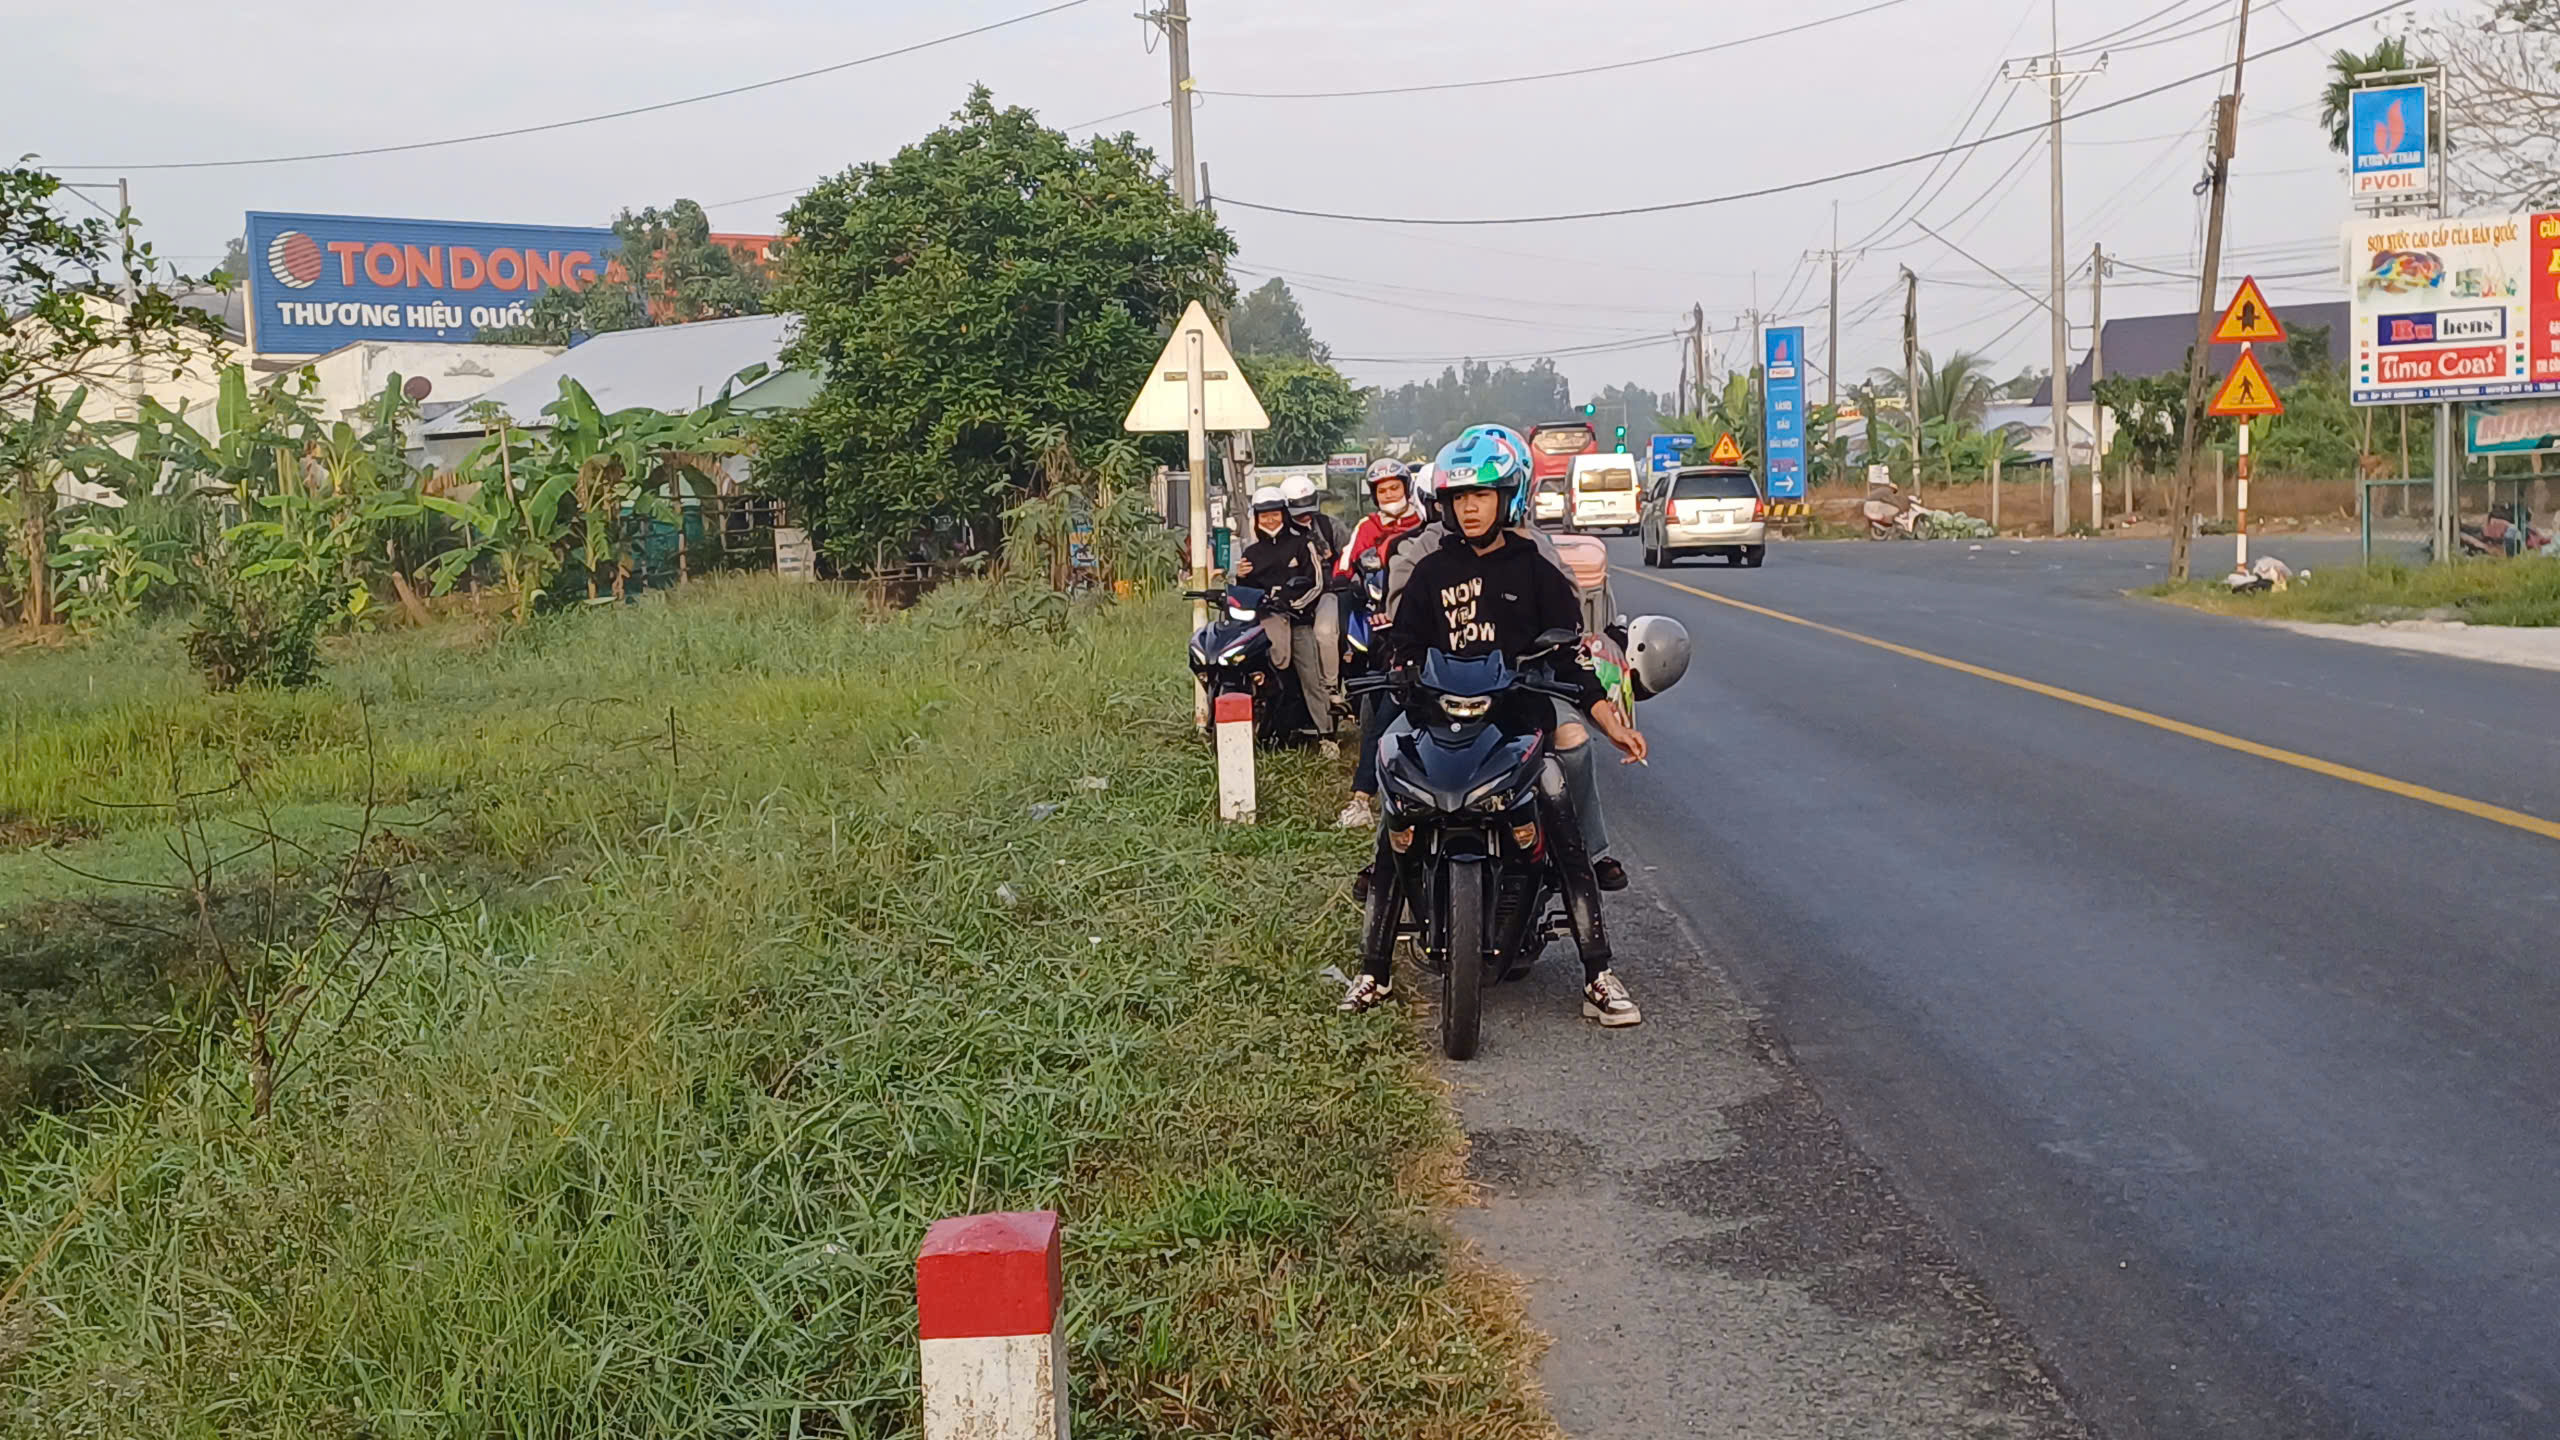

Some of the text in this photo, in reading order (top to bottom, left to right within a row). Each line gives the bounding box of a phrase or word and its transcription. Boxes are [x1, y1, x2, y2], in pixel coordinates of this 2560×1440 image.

[2361, 173, 2417, 190] PVOIL
[277, 302, 400, 327] THƯƠNG
[406, 300, 462, 336] HIỆU
[2438, 351, 2496, 377] Coat
